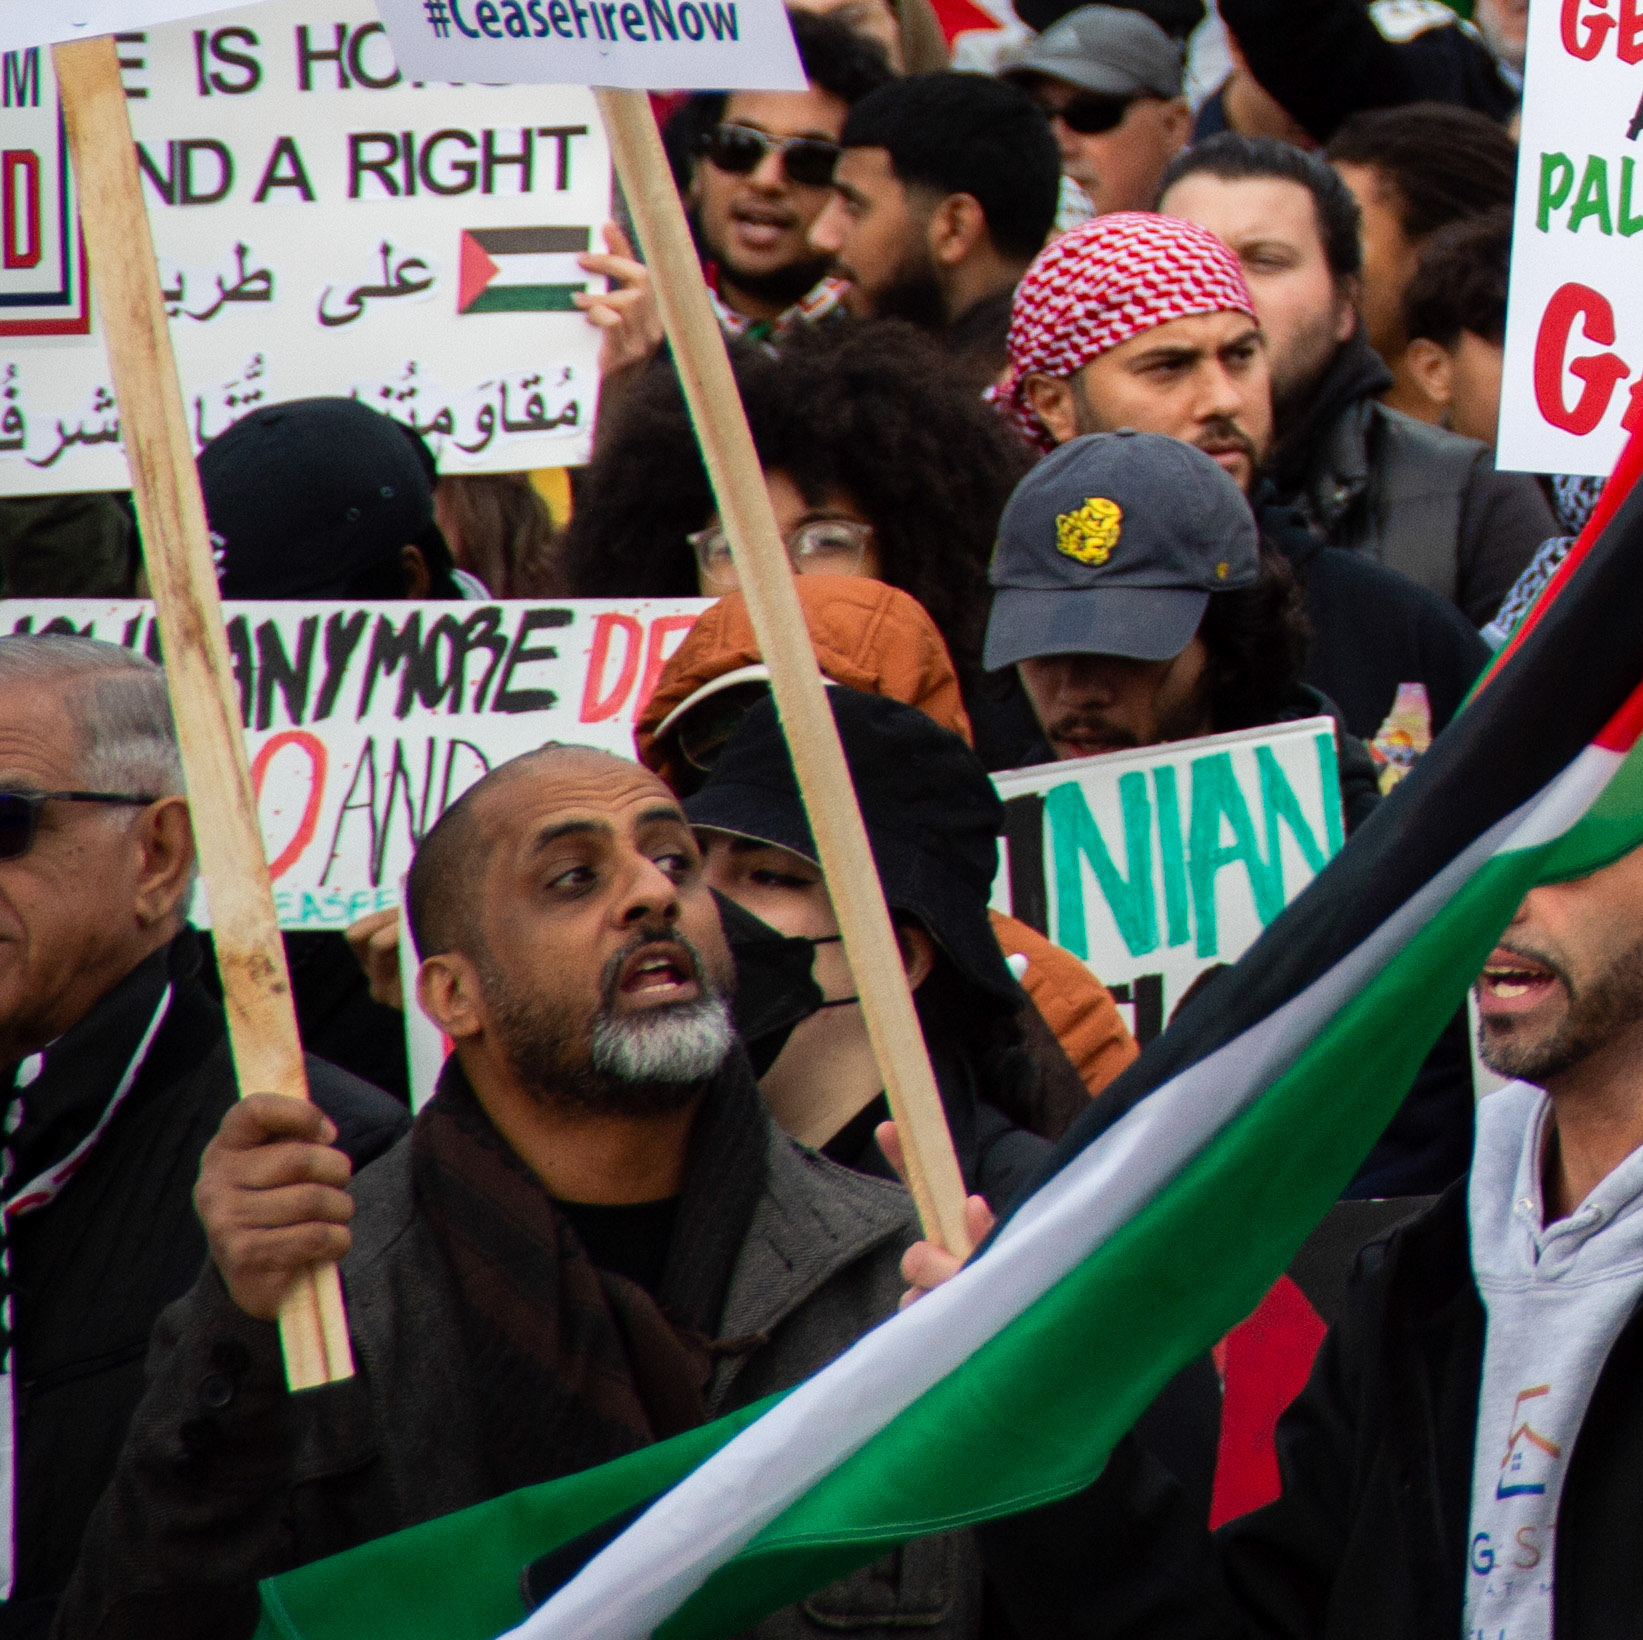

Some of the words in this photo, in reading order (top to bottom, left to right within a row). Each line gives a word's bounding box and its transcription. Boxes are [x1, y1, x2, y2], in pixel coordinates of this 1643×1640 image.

[193, 25, 263, 97] IS
[253, 136, 317, 203] A
[347, 125, 589, 200] RIGHT
[317, 239, 435, 326] على
